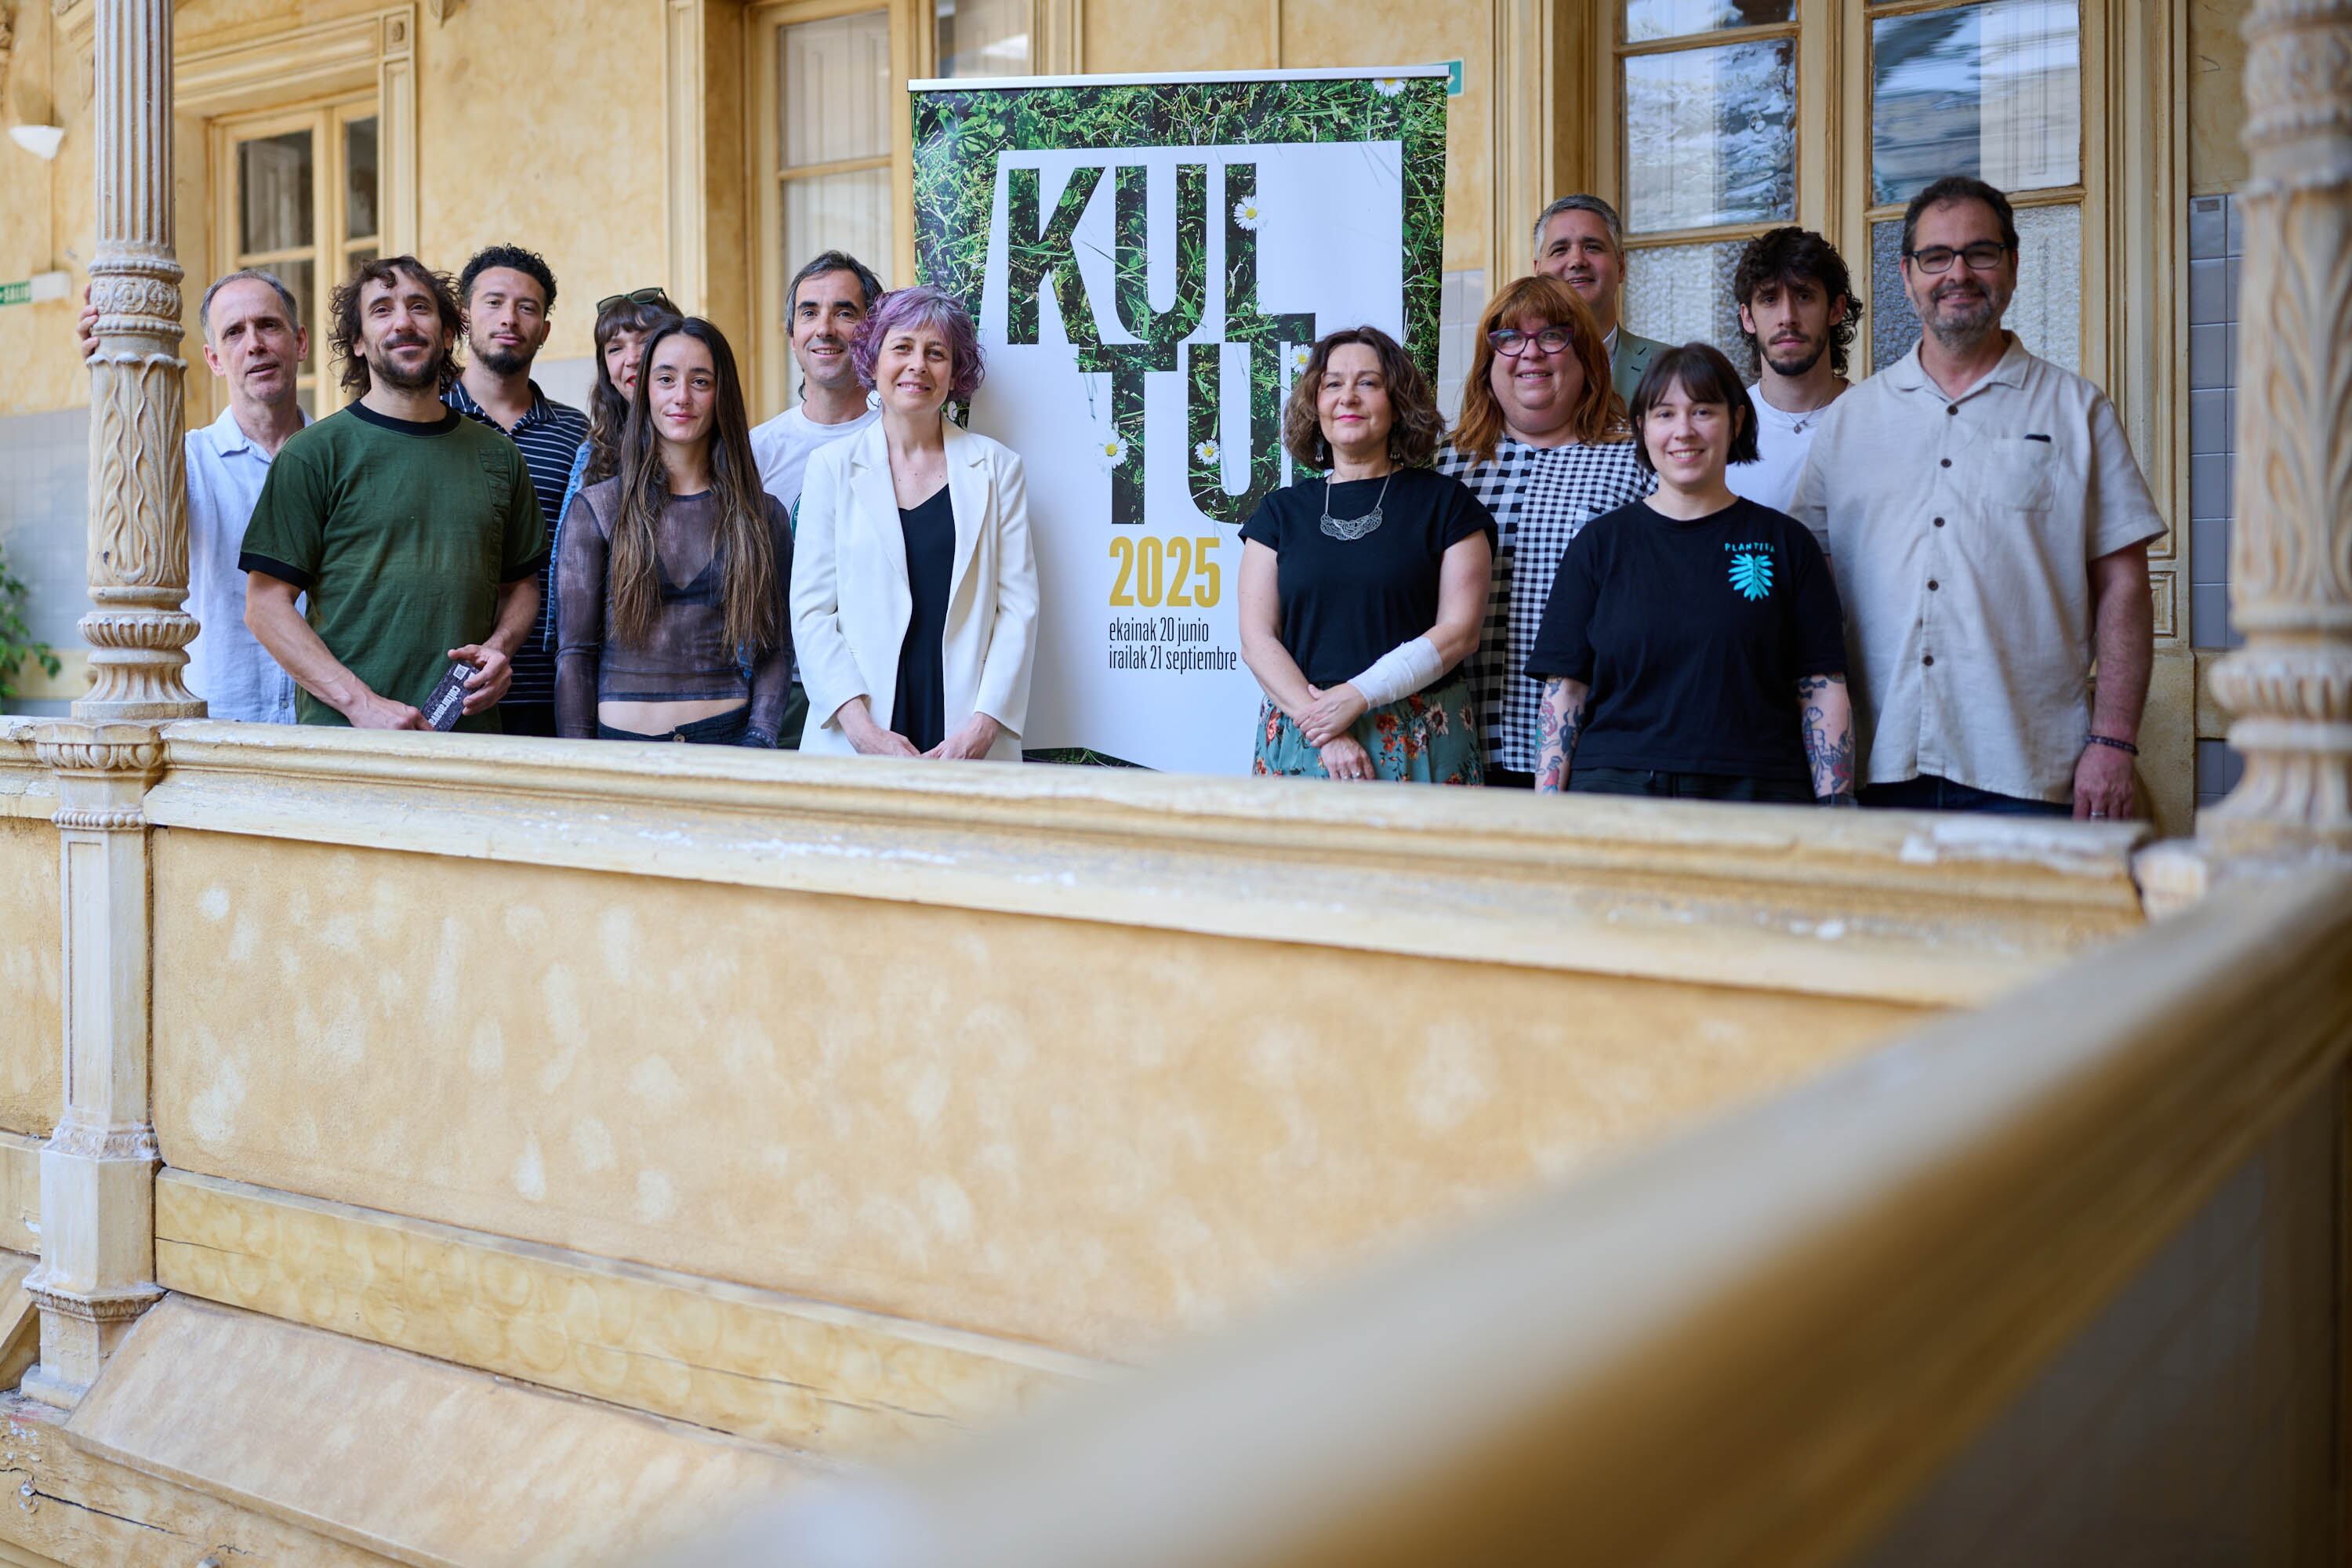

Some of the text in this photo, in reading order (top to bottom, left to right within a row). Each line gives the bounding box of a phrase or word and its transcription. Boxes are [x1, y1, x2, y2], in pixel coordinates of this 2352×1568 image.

[1007, 162, 1316, 345] KUL
[1078, 337, 1325, 524] TU
[1109, 536, 1221, 608] 2025
[1109, 617, 1209, 646] ekainak 20 junio
[1109, 645, 1236, 674] irailak 21 septiembre
[427, 684, 461, 728] culturanava
